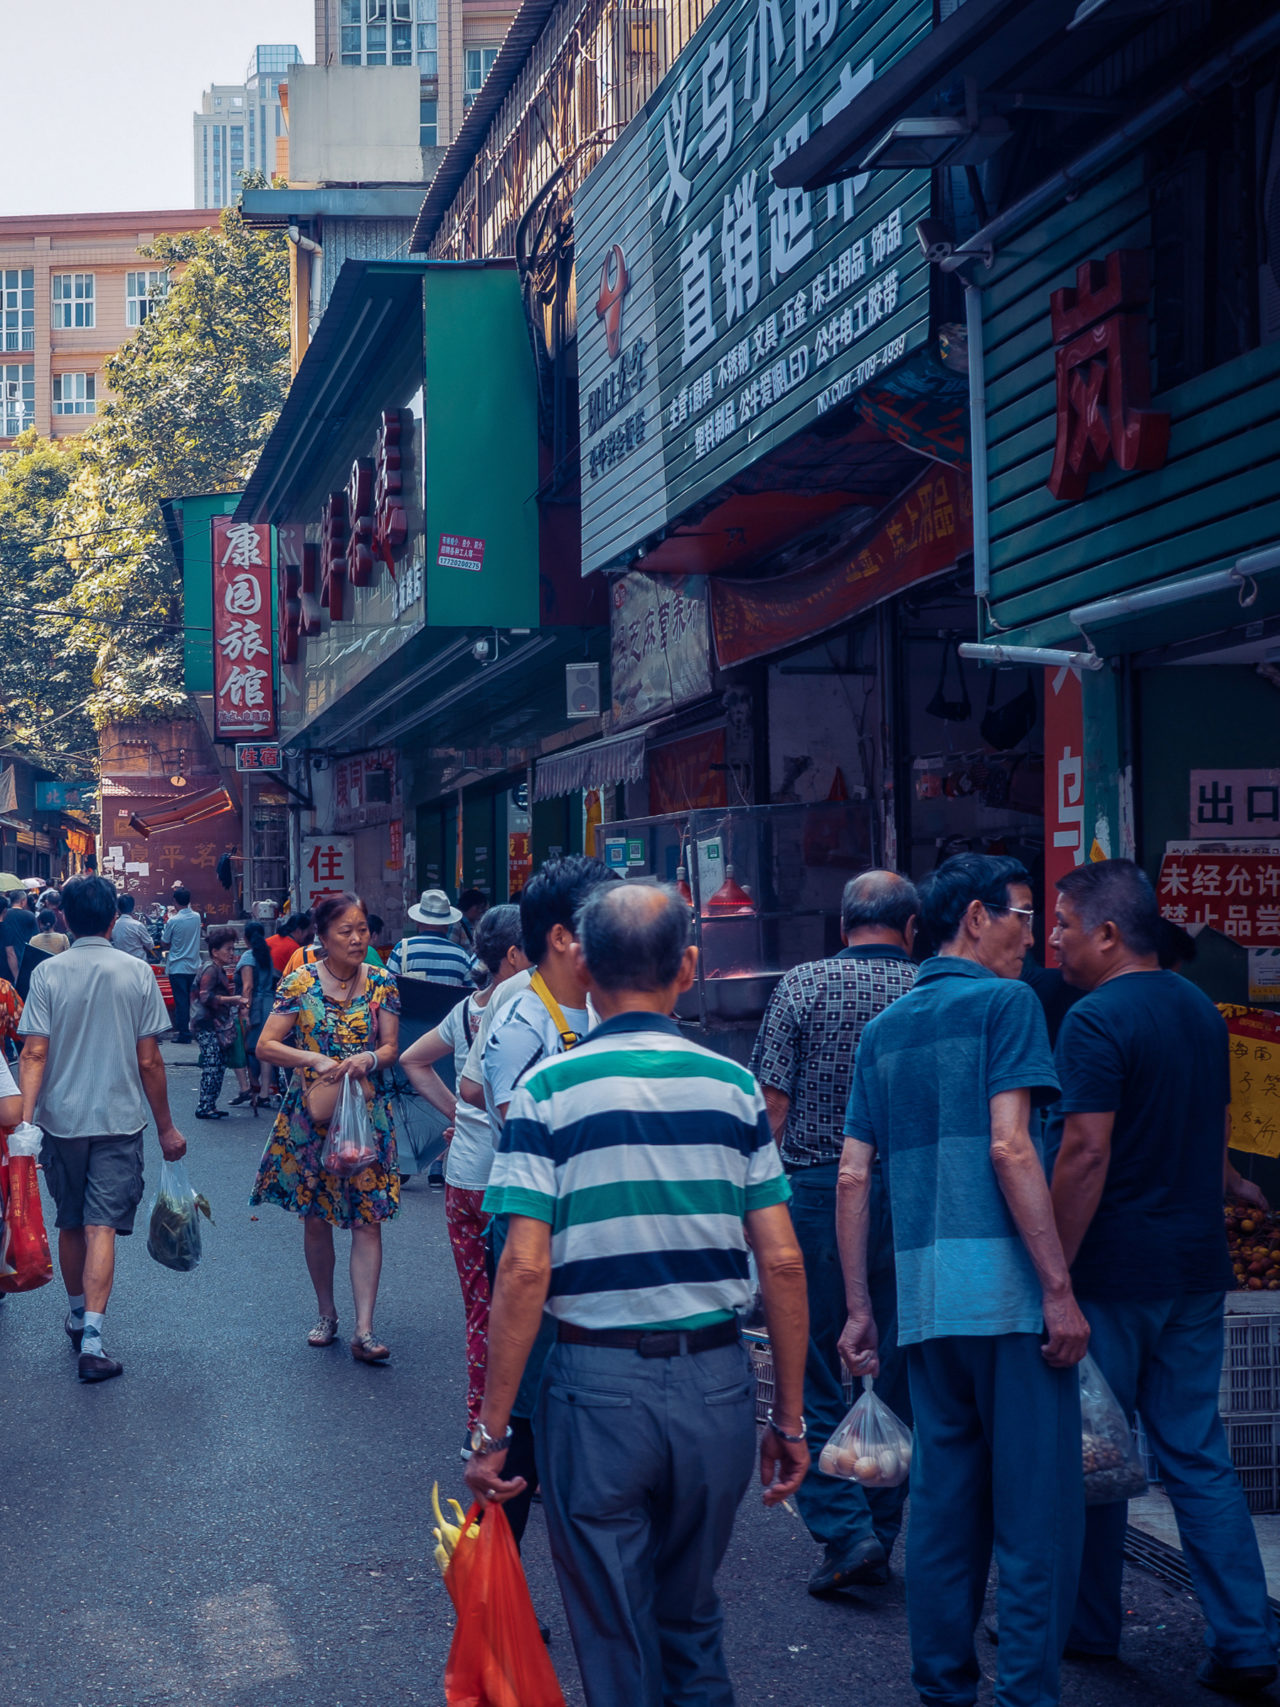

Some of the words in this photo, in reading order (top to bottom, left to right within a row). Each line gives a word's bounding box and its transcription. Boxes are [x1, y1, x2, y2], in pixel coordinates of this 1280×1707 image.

[661, 0, 861, 226] 义乌小
[718, 337, 751, 390] 不锈钢
[754, 313, 778, 362] 文具
[782, 289, 808, 338] 五金
[812, 238, 866, 315] 床上用品
[871, 207, 903, 268] 饰品
[695, 400, 737, 460] 塑料制品
[815, 269, 900, 366] 公牛电工胶带
[241, 749, 277, 767] 住宿
[1198, 781, 1279, 825] 出口
[1160, 864, 1280, 898] 未经允许
[1160, 903, 1280, 938] 禁止品尝
